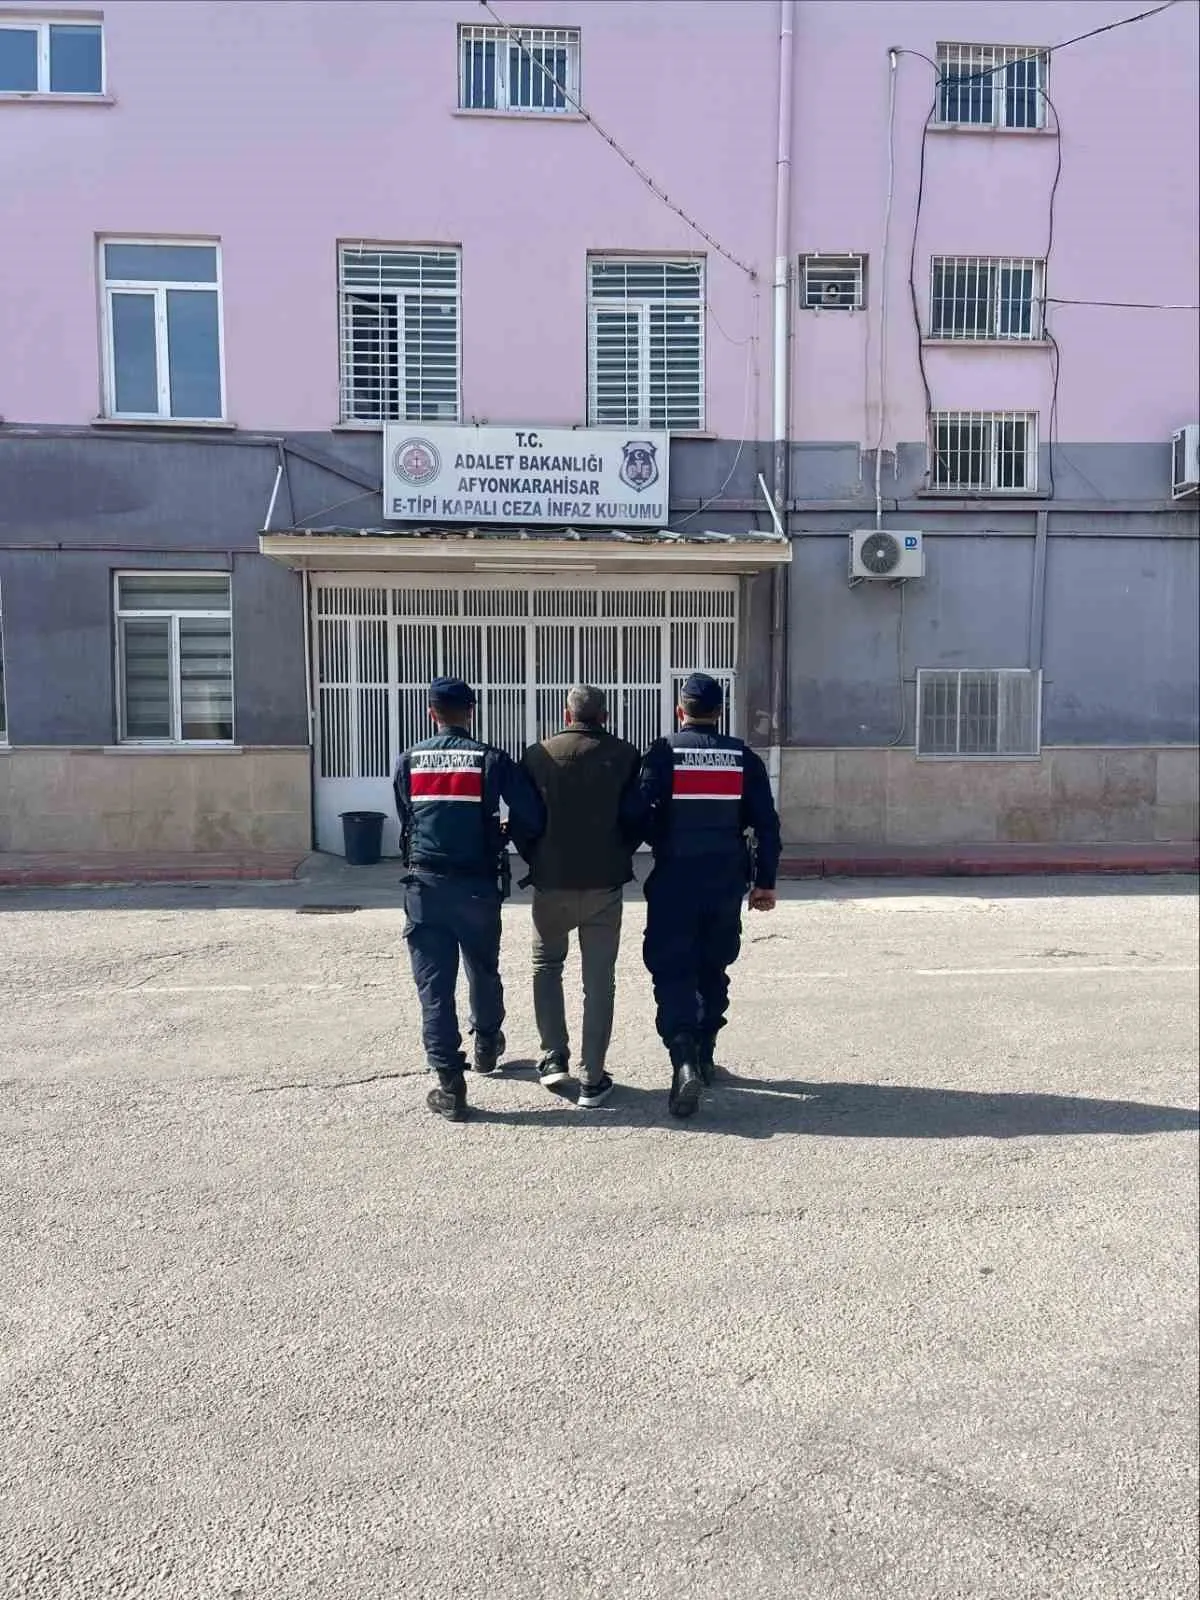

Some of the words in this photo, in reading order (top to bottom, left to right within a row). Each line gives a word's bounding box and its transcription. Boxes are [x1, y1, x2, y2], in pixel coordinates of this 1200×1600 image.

[515, 432, 543, 448] T.C.
[454, 453, 515, 470] ADALET
[519, 454, 603, 473] BAKANLIĞI
[458, 475, 600, 495] AFYONKARAHİSAR
[392, 495, 437, 514] E-TİPİ
[442, 499, 497, 516] KAPALI
[502, 501, 542, 516] CEZA
[547, 498, 591, 517] İNFAZ
[595, 503, 663, 519] KURUMU
[416, 753, 475, 769] JANDARMA
[681, 752, 737, 768] JANDARMA
